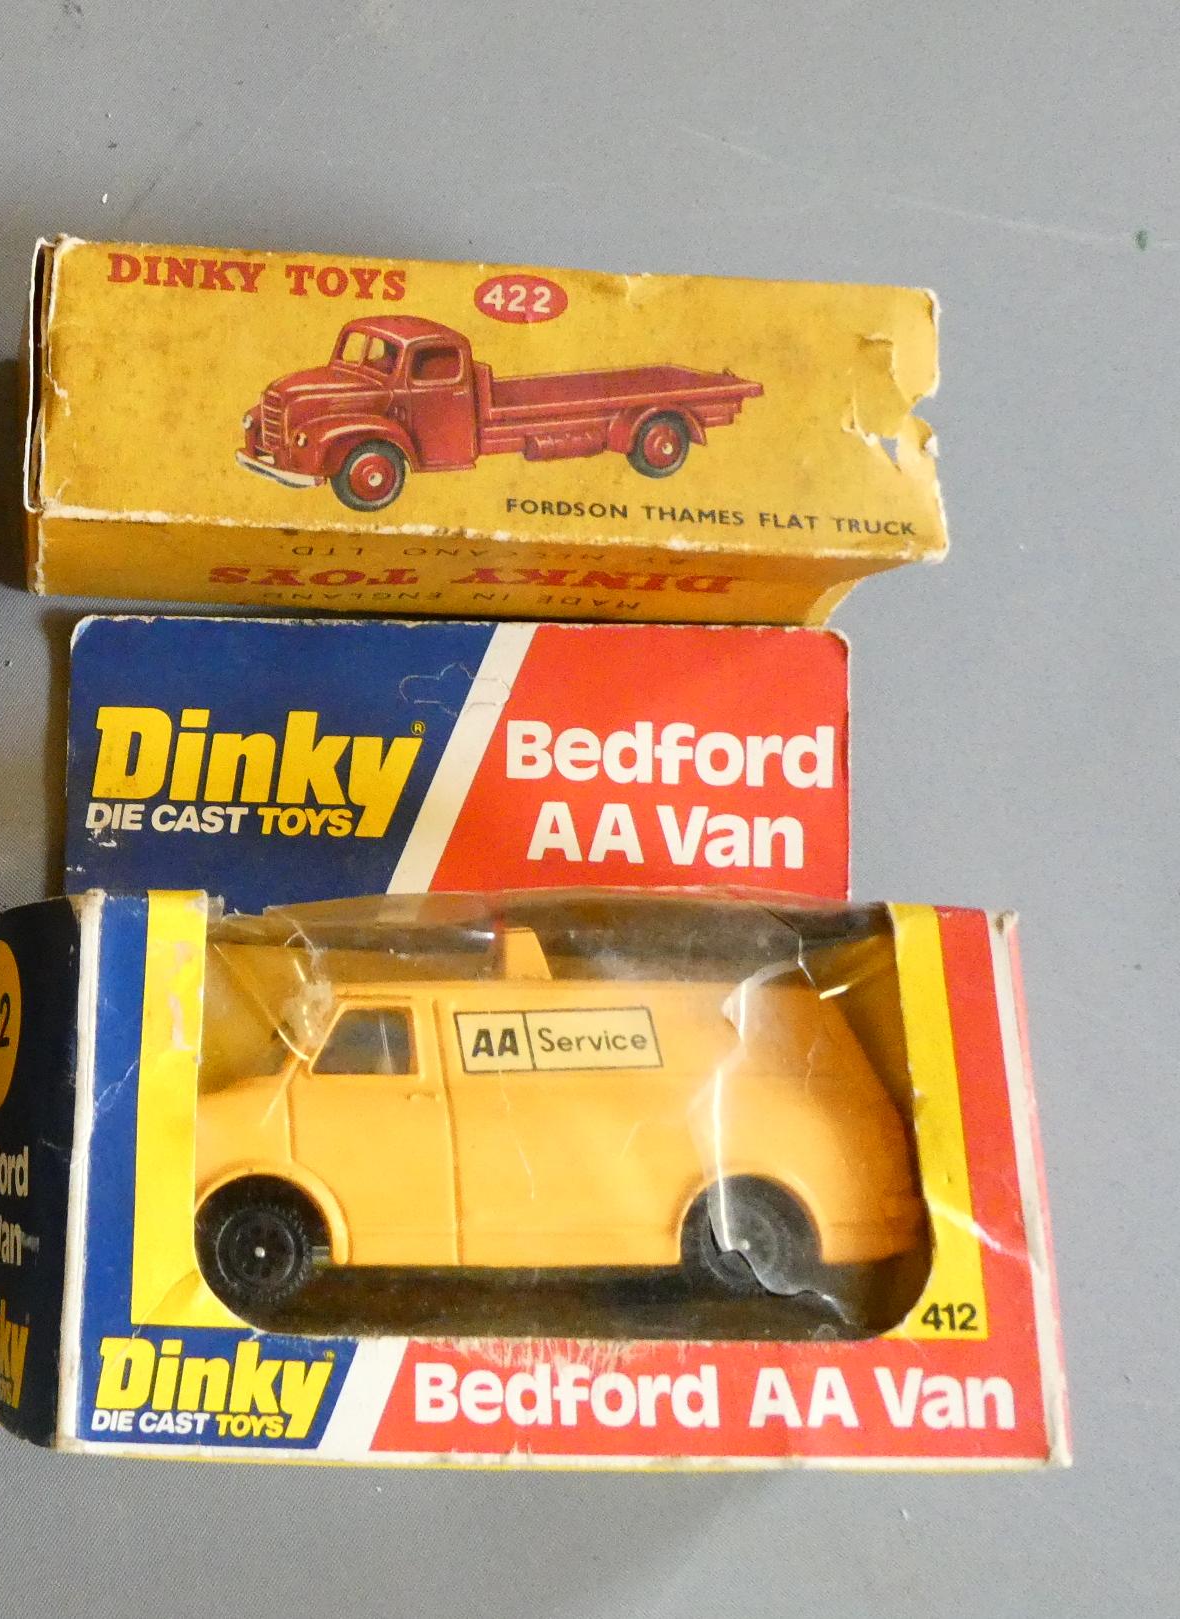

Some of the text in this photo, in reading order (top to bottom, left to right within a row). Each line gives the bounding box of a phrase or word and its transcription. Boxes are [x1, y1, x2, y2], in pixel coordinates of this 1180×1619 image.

[107, 253, 407, 300] DINKY TOYS
[482, 283, 552, 314] 422
[506, 498, 918, 536] FORDSON THAMES FLAT TRUCK
[208, 566, 740, 594] DINKY TOYS
[91, 706, 423, 838] Dinky
[506, 720, 835, 789] Bedford
[85, 802, 355, 837] DIE CAST TOYS
[656, 805, 804, 869] Van
[471, 1027, 647, 1057] AA Service
[920, 1303, 978, 1331] 412
[95, 1337, 333, 1439] Dinky
[413, 1362, 719, 1427] Bedford
[873, 1366, 1016, 1430] Van
[91, 1409, 285, 1438] DIE CAST TOYS
